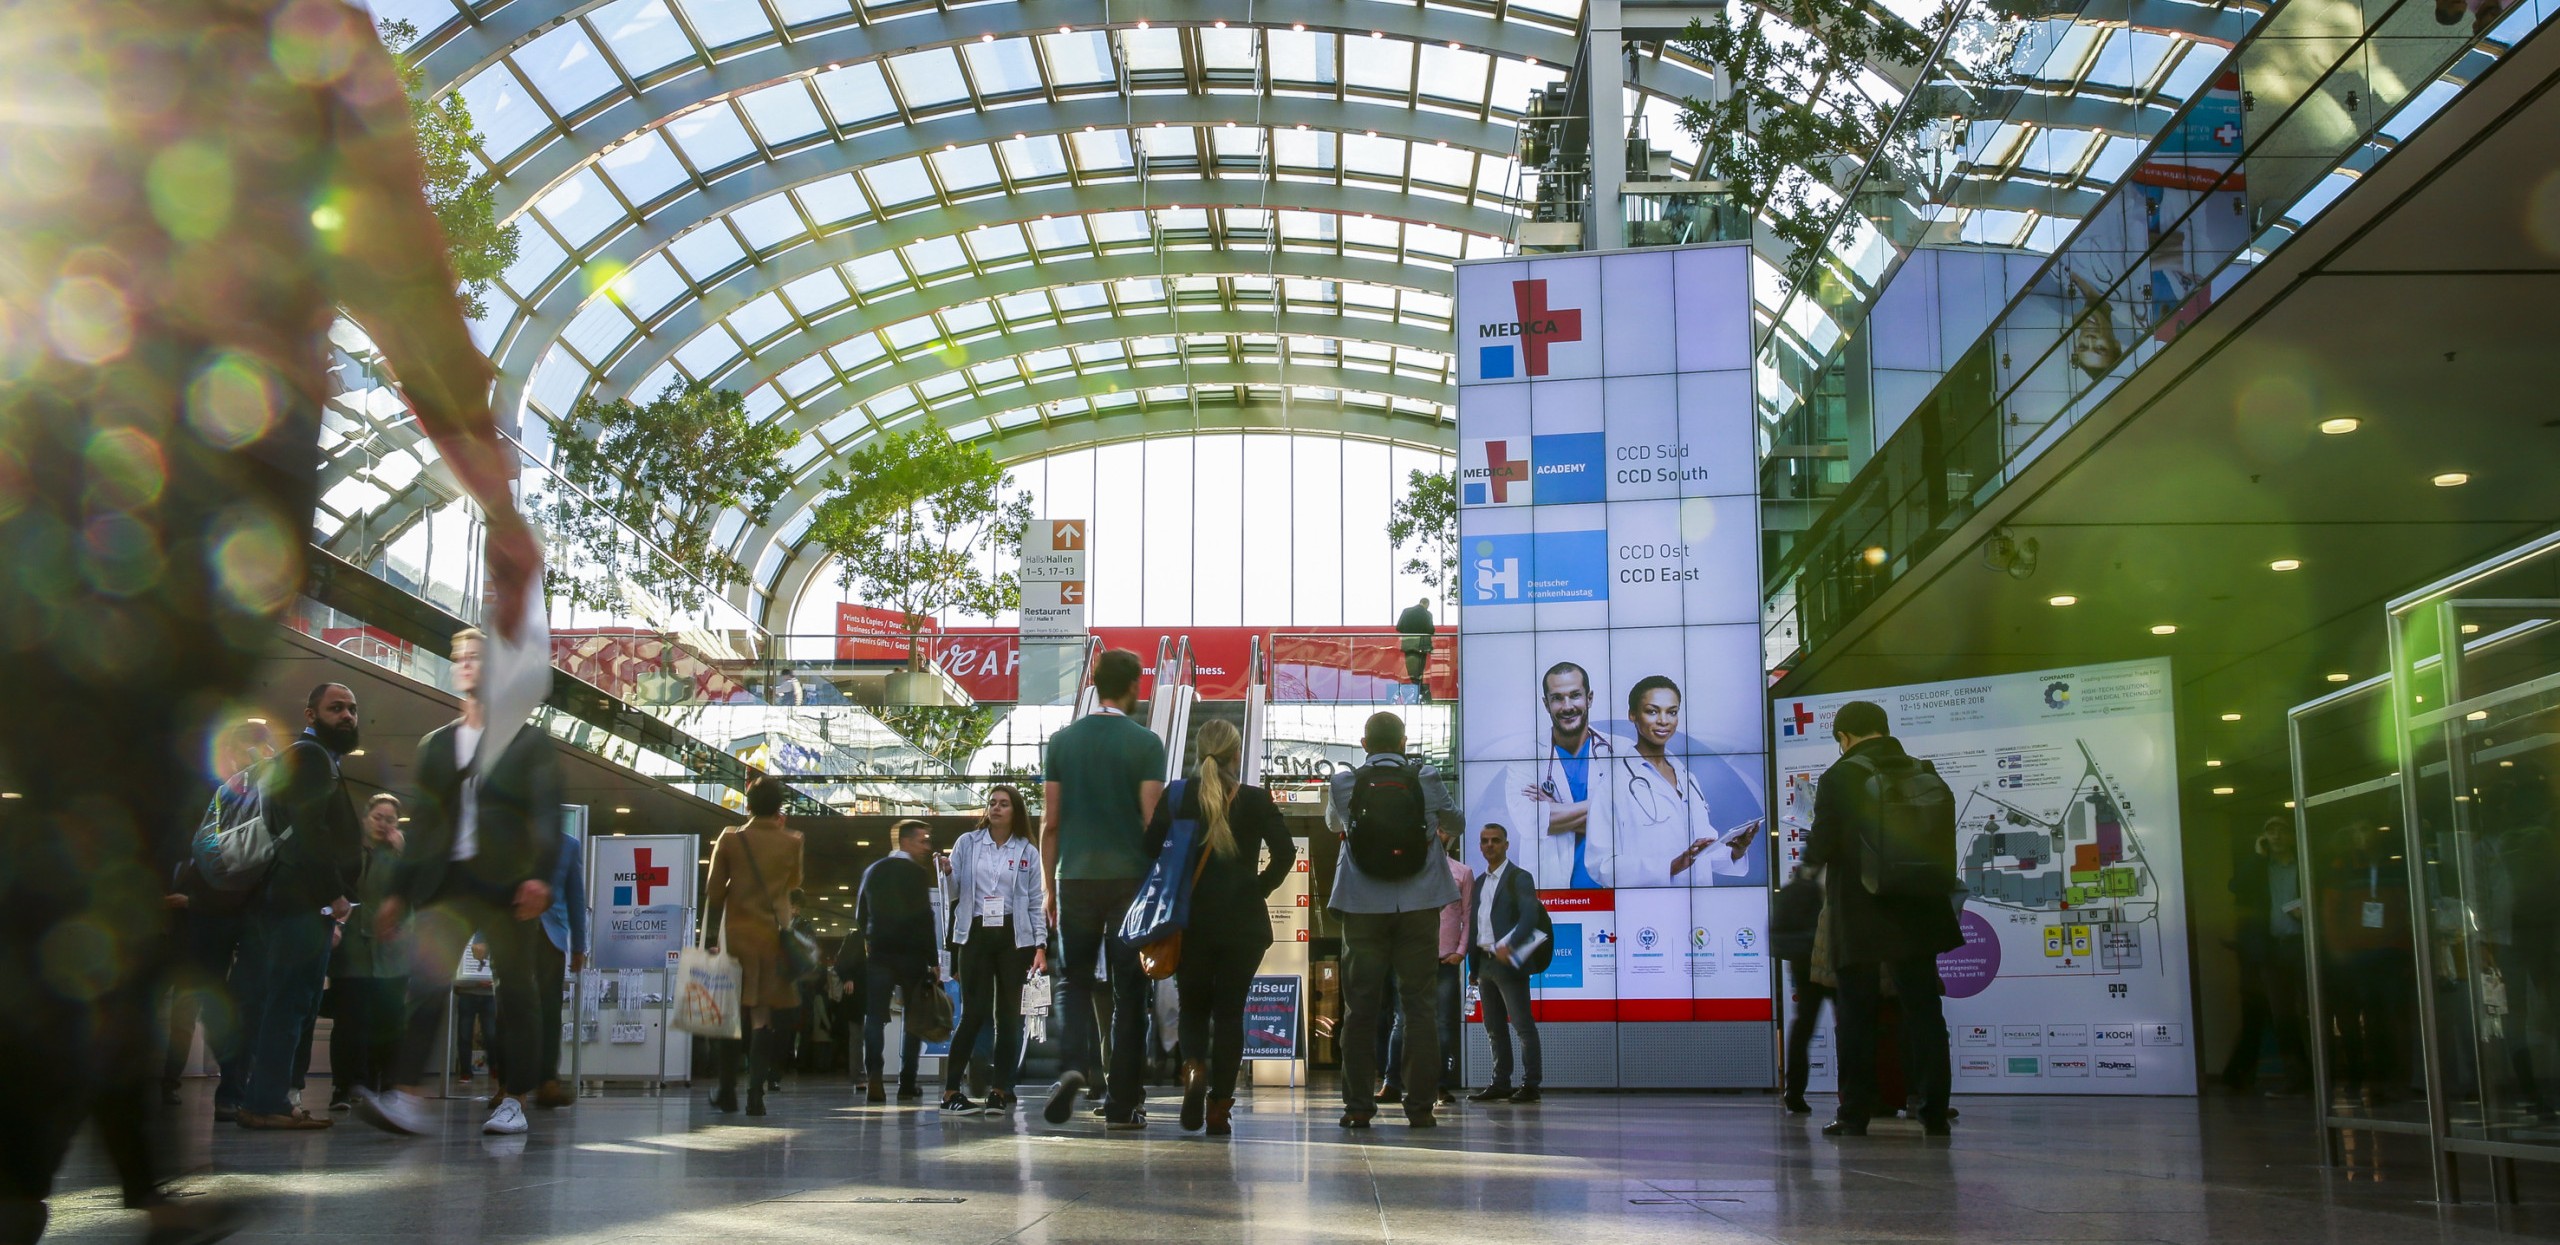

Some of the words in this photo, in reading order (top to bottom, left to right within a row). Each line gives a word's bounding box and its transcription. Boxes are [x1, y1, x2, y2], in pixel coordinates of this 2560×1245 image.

[1479, 320, 1558, 338] MEDICA
[1616, 446, 1650, 461] CCD
[1656, 444, 1689, 459] Süd
[1464, 467, 1514, 478] MEDICA
[1537, 463, 1586, 475] ACADEMY
[1617, 468, 1651, 484] CCD
[1656, 466, 1708, 482] South
[1619, 544, 1654, 560] CCD
[1660, 543, 1689, 558] Ost
[1026, 556, 1073, 564] Halls/Hallen
[1620, 568, 1655, 584] CCD
[1661, 566, 1700, 582] East
[1528, 579, 1568, 588] Deutscher
[1528, 588, 1593, 599] Krankenhaustag
[843, 614, 860, 622] Prints
[866, 618, 884, 628] Copies
[846, 624, 870, 634] Business
[877, 638, 890, 648] Gifts
[1196, 665, 1226, 675] iness.
[2040, 673, 2075, 682] COMPAMED
[2115, 683, 2149, 691] SOLUTIONS
[1899, 690, 1952, 702] DÜSSELDORF,
[1954, 686, 1992, 696] GERMANY
[2095, 694, 2120, 702] MEDICAL
[2122, 689, 2162, 698] TECHNOLOGY
[1922, 698, 1966, 709] NOVEMBER
[1968, 696, 1985, 704] 2018
[1819, 712, 1836, 720] WOR
[614, 872, 656, 881] MEDICA
[612, 920, 667, 931] WELCOME
[1554, 948, 1573, 956] WEEK
[1250, 982, 1295, 993] riseur
